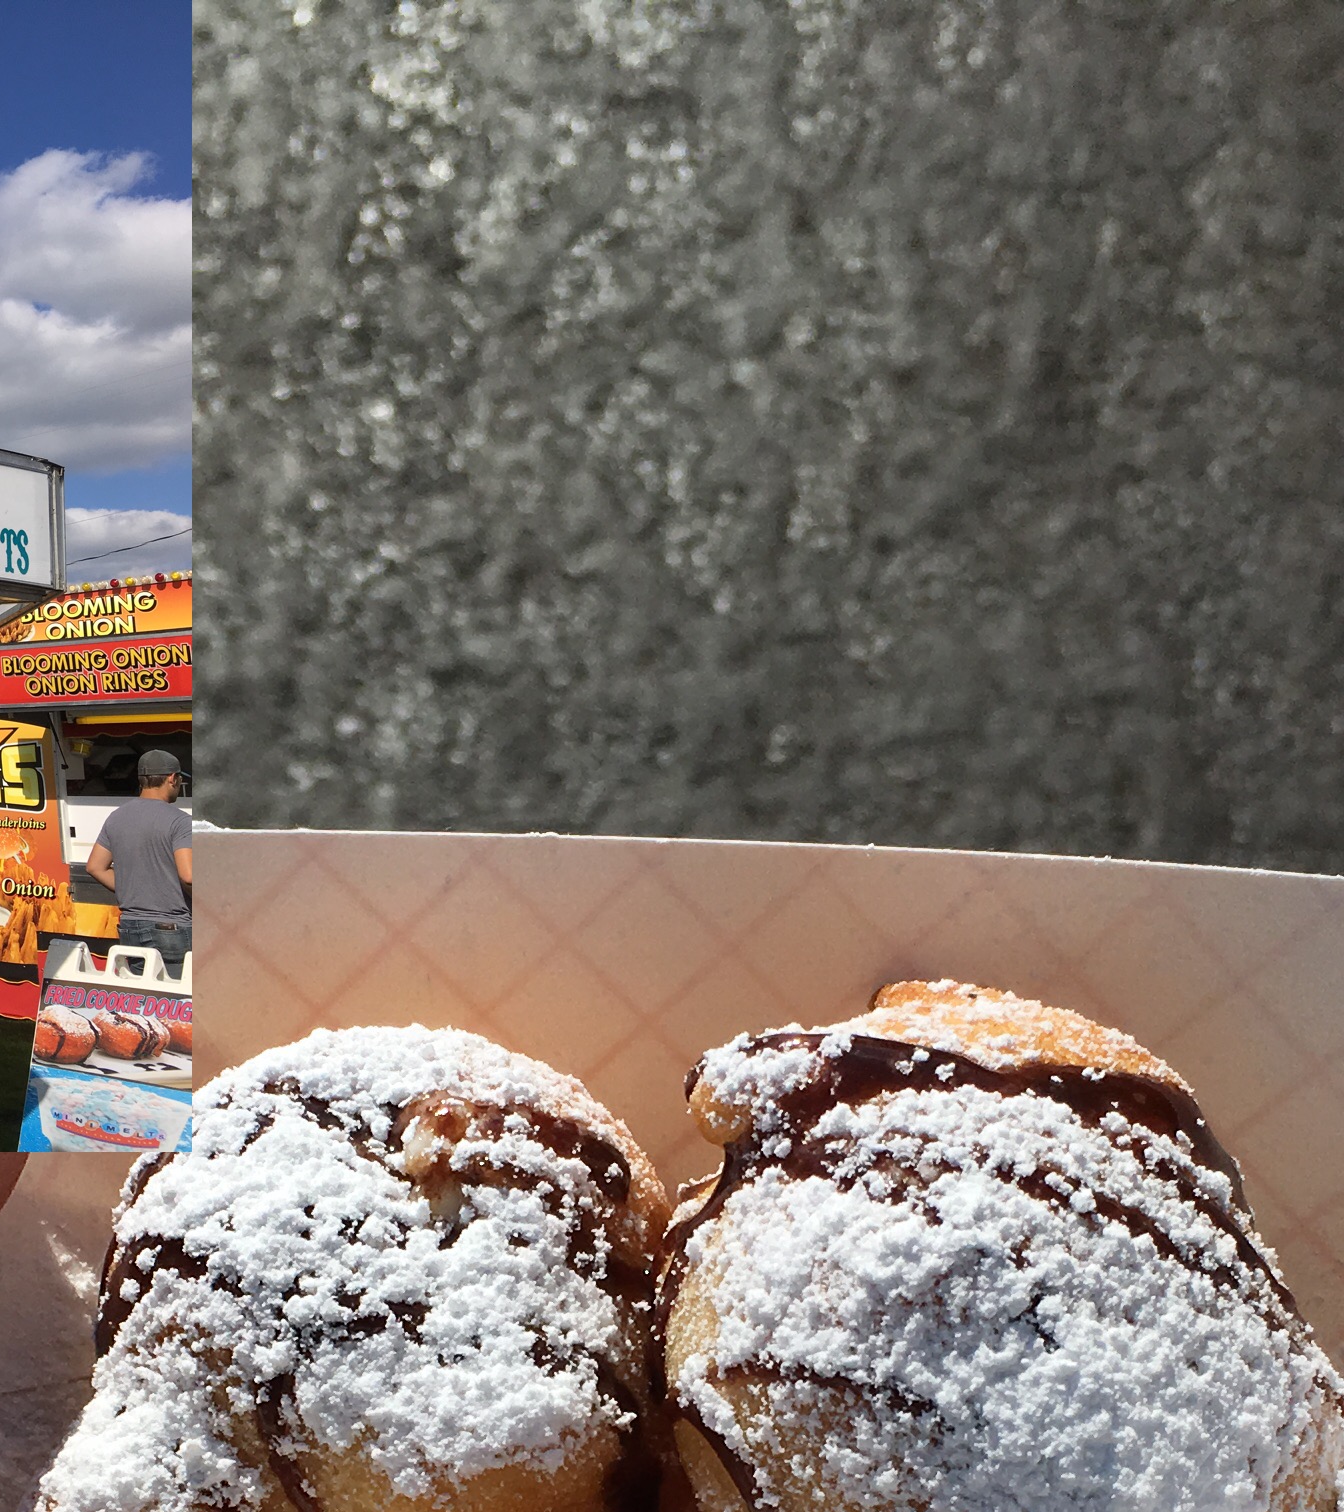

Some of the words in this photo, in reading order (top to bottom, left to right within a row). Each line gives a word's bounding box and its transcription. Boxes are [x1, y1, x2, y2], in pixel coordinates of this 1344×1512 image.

[45, 615, 137, 640] ONION
[2, 649, 108, 676] BLOOMING
[112, 643, 192, 670] ONION
[25, 672, 97, 696] ONION
[102, 669, 169, 694] RINGS
[1, 877, 55, 898] Onion
[44, 985, 86, 1008] FRIED
[86, 989, 142, 1015] COOKIE
[143, 995, 192, 1023] DOUG
